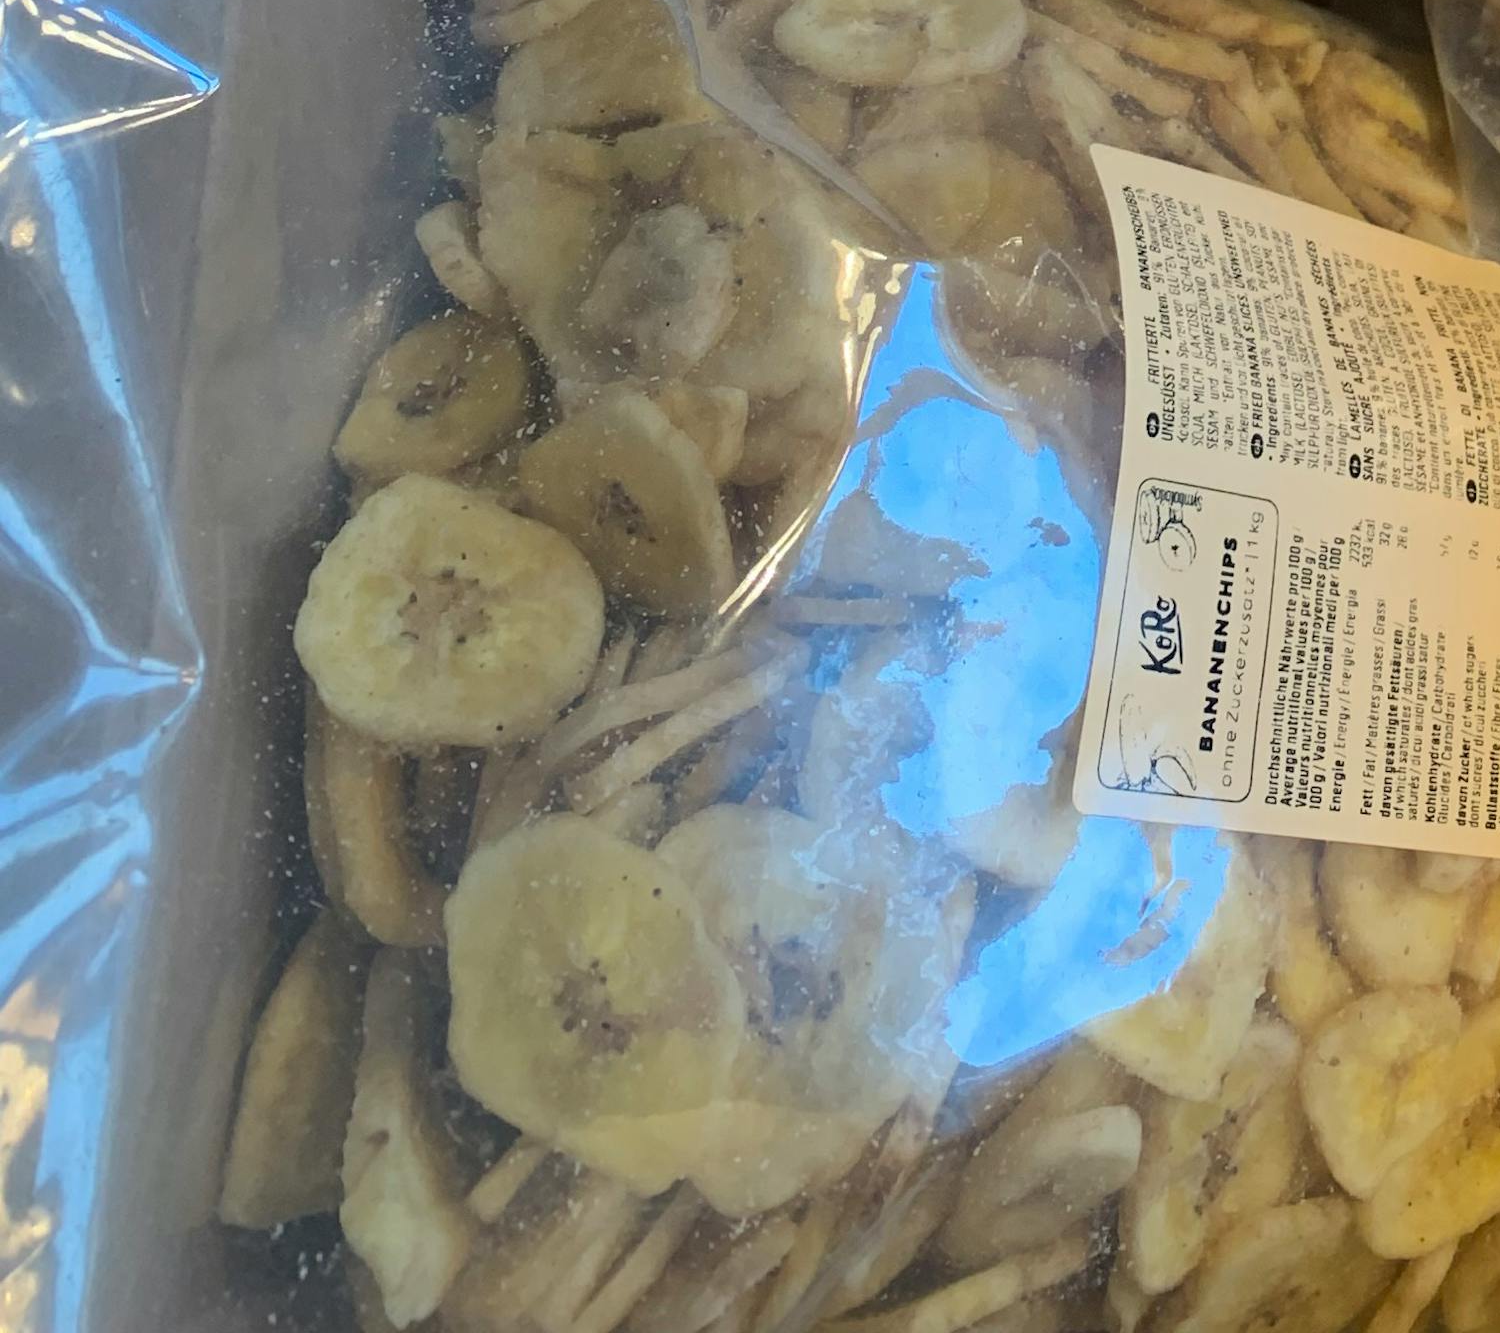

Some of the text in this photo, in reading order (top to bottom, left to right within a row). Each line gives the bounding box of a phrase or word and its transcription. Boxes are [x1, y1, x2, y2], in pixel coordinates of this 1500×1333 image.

[1123, 186, 1160, 384] FRITTIERTE BANANENSCHEIBEN
[1218, 211, 1245, 289] UNSWEETENED
[1158, 293, 1175, 441] UNGESÜSST Zutaten:
[1241, 337, 1261, 388] BANANA
[1247, 391, 1263, 429] FRIED
[1359, 395, 1374, 481] SANS SUCRE
[1464, 429, 1476, 467] FETTE
[1300, 568, 1313, 590] 100
[1301, 595, 1312, 617] per
[1139, 596, 1182, 674] KoRo
[1199, 537, 1237, 752] BANANENCHIPS
[1265, 535, 1304, 804] Durchschnittliche Nährwerte pro 100 g
[1296, 621, 1308, 664] values
[1287, 669, 1304, 744] nutritional
[1295, 541, 1332, 807] Valeurs nutritionnelles moyennes pour
[1309, 537, 1345, 809] 100 g Valori nutrizionali medi per 100 g
[1280, 749, 1297, 806] Average
[1329, 760, 1345, 812] Energie
[1360, 789, 1373, 815] Fett
